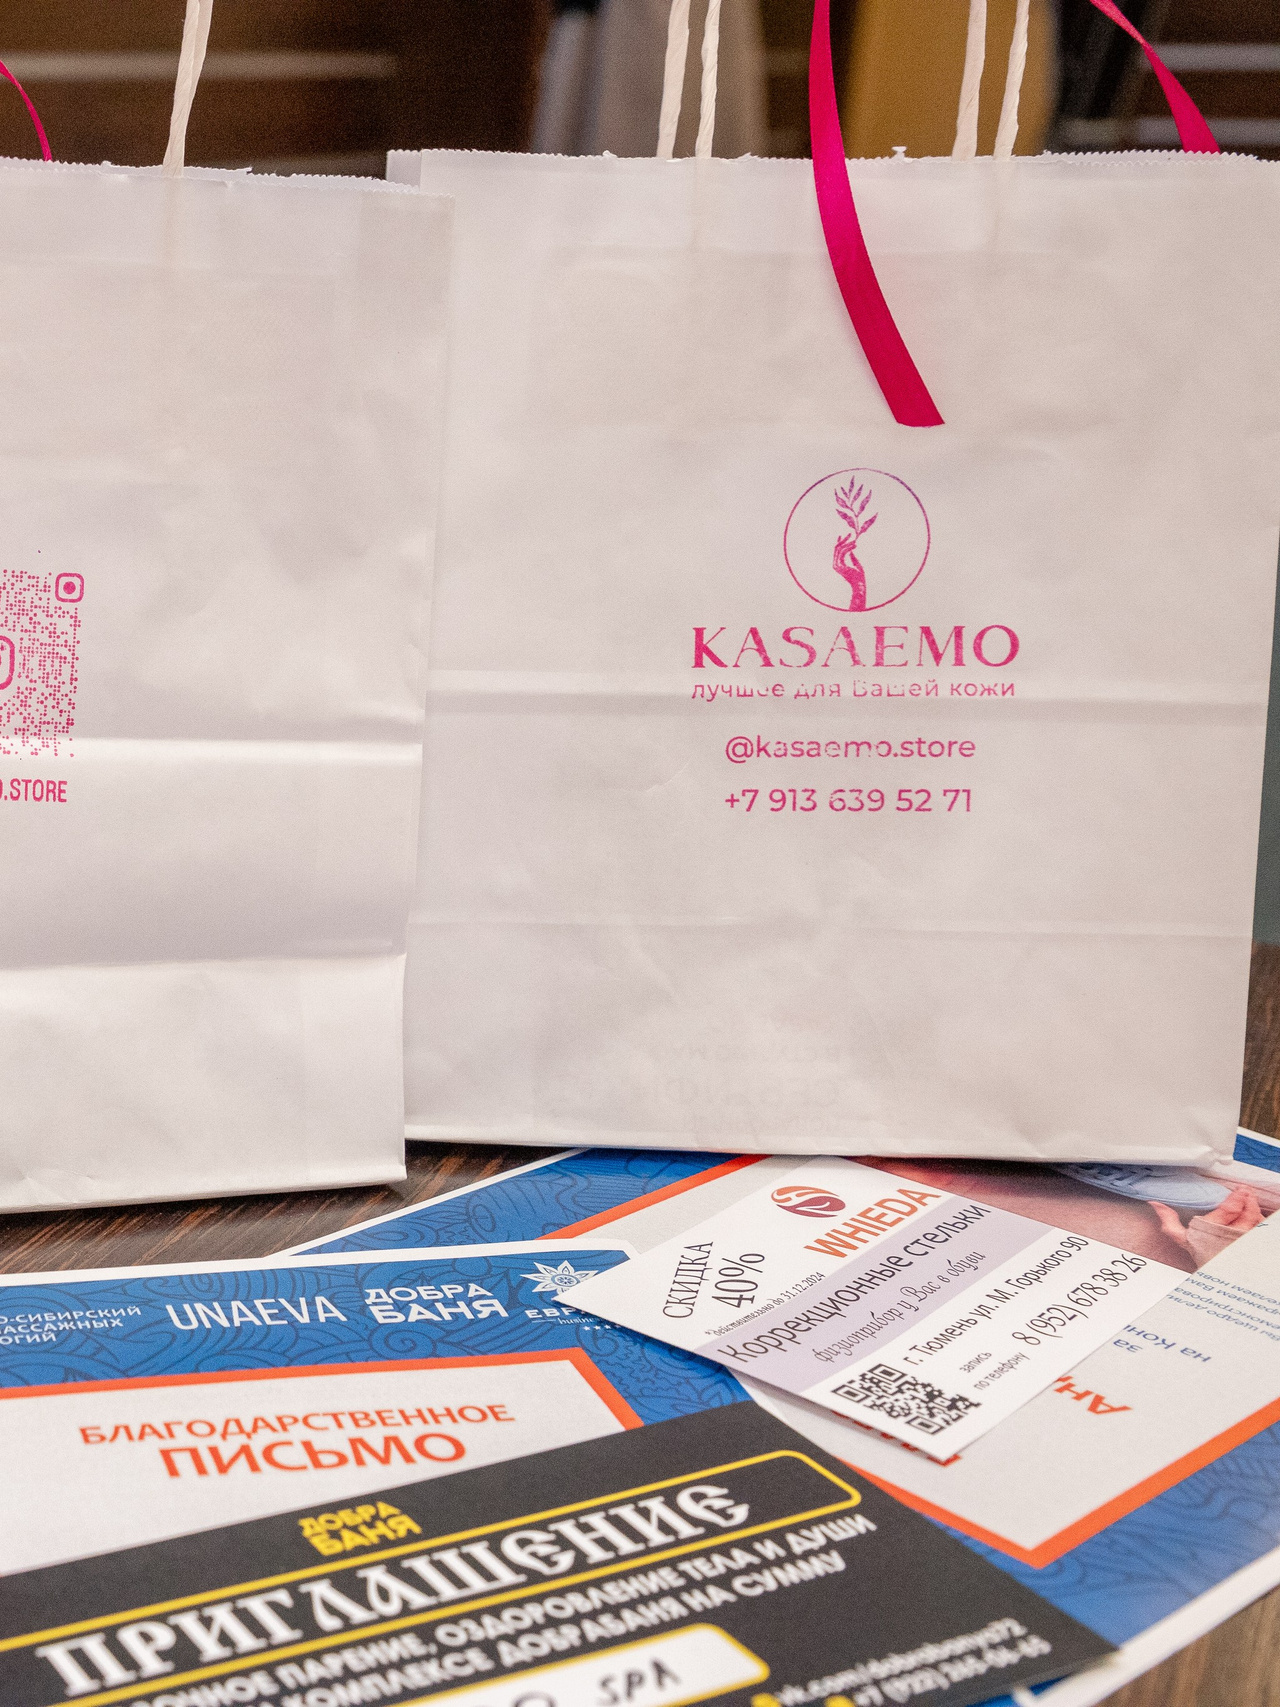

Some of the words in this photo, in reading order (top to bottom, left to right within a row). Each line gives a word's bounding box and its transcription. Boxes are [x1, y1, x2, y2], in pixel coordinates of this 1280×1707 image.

[691, 624, 1020, 668] KASAEMO
[691, 682, 785, 702] лучшее
[794, 682, 841, 699] для
[852, 679, 939, 698] Вашей
[950, 682, 1016, 698] кожи
[725, 735, 976, 764] @kasaemo.store
[725, 789, 759, 812] +7
[768, 789, 817, 812] 913
[828, 789, 885, 812] 639
[896, 789, 933, 812] 52
[942, 789, 972, 812] 71
[804, 1188, 942, 1259] WHIEDA
[1060, 1235, 1089, 1251] 90
[663, 1241, 714, 1319] СКИДКА
[1004, 1247, 1072, 1289] Горького
[1091, 1267, 1128, 1288] 38
[1111, 1253, 1147, 1273] 26
[363, 1283, 494, 1306] ДОБРА
[712, 1253, 765, 1308] 40%
[717, 1254, 914, 1362] Коррекционные
[903, 1204, 992, 1257] стельки
[781, 1271, 826, 1300] 31.12.2024
[985, 1288, 1019, 1303] М.
[1067, 1282, 1109, 1307] 678
[165, 1295, 347, 1332] UNAEVA
[369, 1298, 510, 1325] БАНЯ
[812, 1311, 905, 1363] физиоприбор
[900, 1281, 941, 1302] Вас
[936, 1274, 951, 1284] в
[947, 1251, 986, 1278] обуви
[968, 1304, 999, 1320] ул.
[1025, 1304, 1089, 1338] (952)
[1174, 1286, 1280, 1330] емонстрирова
[909, 1318, 978, 1355] Тюмень
[1011, 1331, 1041, 1346] 8
[1112, 1337, 1144, 1354] за
[903, 1356, 924, 1365] г.
[959, 1352, 992, 1373] запись
[974, 1380, 990, 1390] по
[984, 1352, 1030, 1382] телефону
[1179, 1346, 1212, 1363] на
[79, 1404, 516, 1446] БЛАГОДАРСТВЕННОЕ
[158, 1432, 467, 1478] ПИСЬМО
[298, 1501, 402, 1538] ДОБРА
[308, 1514, 423, 1556] БАНЯ
[275, 1633, 438, 1690] ПАРЕНИЕ,
[434, 1565, 687, 1648] ОЗДОРОВЛЕНИЕ
[676, 1548, 759, 1583] ТЕЛА
[755, 1538, 787, 1561] И
[786, 1513, 878, 1557] ДУШИ
[496, 1596, 690, 1668] ДОБРАБАНЯ
[681, 1582, 739, 1614] НА
[731, 1549, 847, 1598] СУММУ
